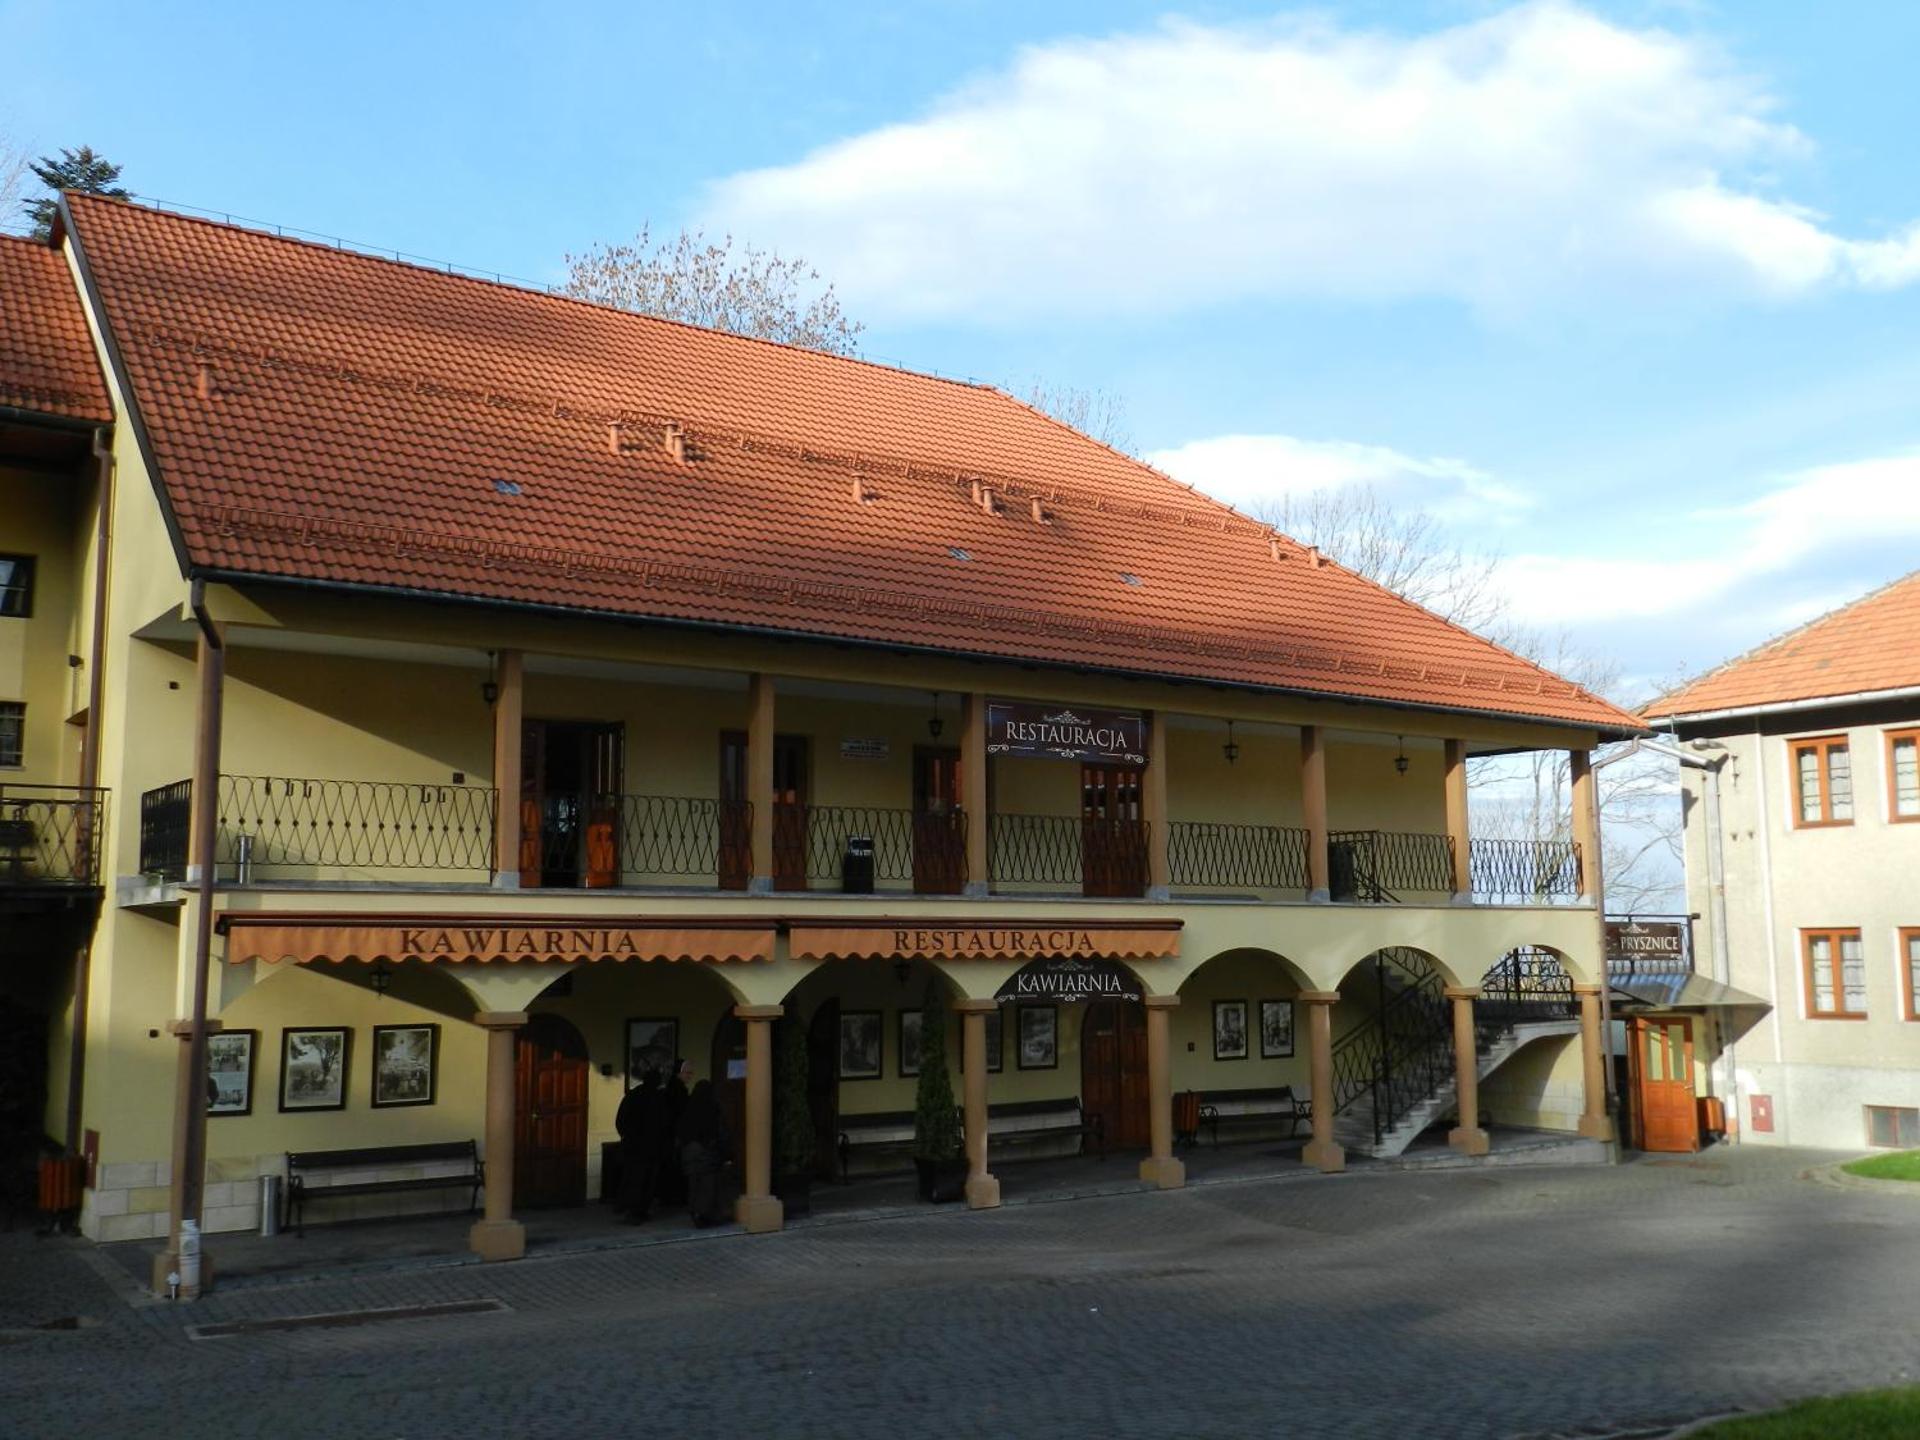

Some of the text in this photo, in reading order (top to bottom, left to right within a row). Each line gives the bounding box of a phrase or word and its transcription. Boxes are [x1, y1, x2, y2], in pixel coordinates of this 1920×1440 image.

[1006, 721, 1127, 751] RESTAURACJA
[400, 929, 638, 954] KAWIARNIA
[894, 930, 1095, 951] RESTAURACJA
[1620, 936, 1679, 951] PRYSZNICE
[1017, 973, 1122, 992] KAWIARNIA
